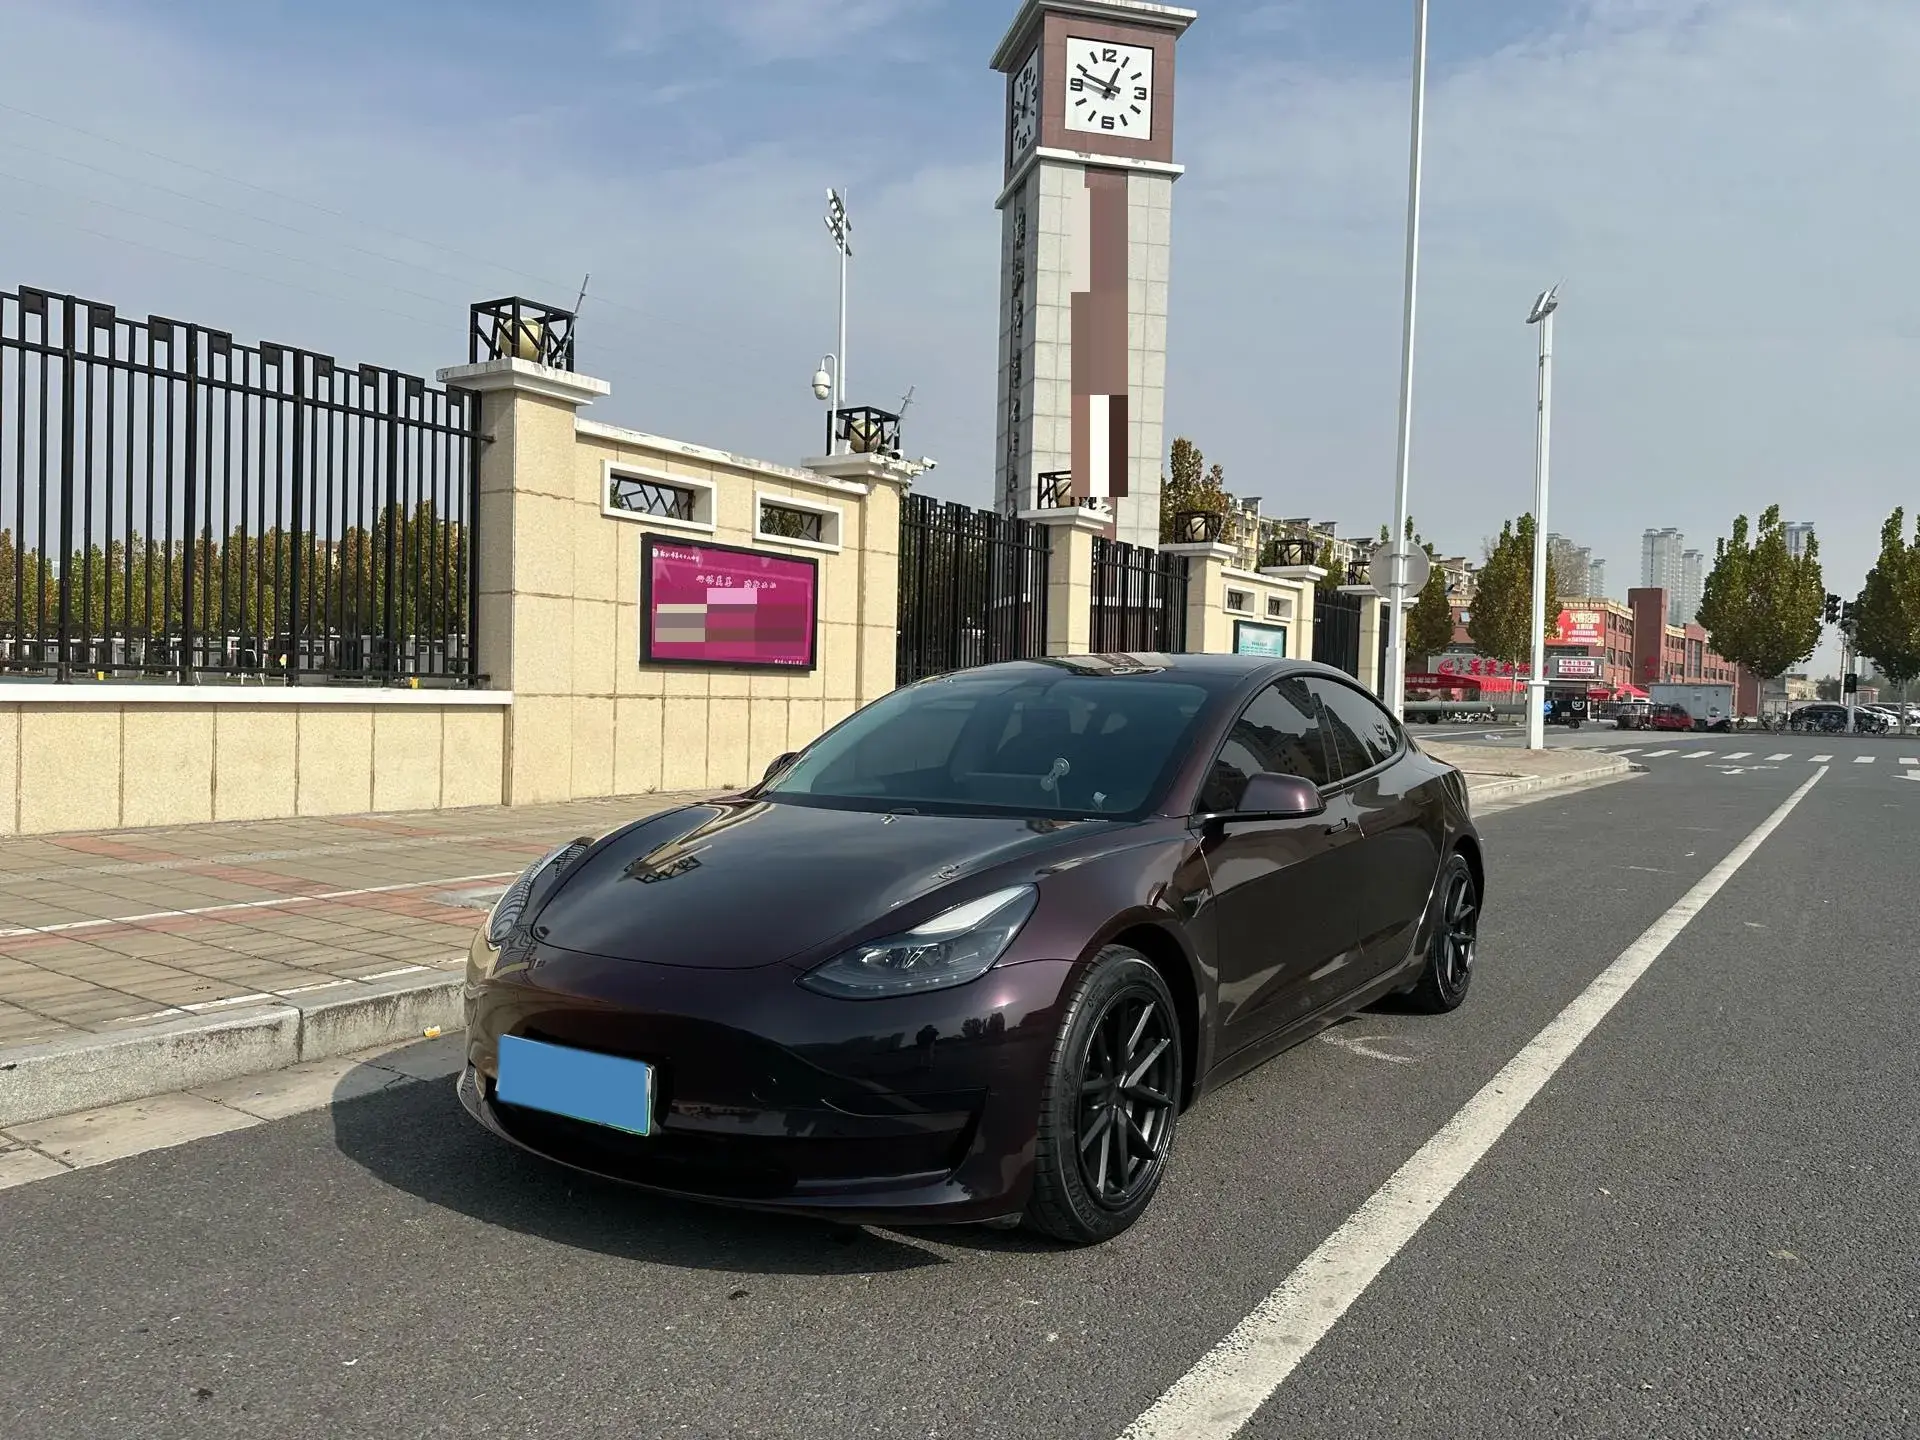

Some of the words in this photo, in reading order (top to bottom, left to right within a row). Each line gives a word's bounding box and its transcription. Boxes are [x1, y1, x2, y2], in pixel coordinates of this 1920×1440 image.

[1102, 48, 1117, 63] 12
[1070, 78, 1084, 92] 9
[1134, 87, 1147, 101] 3
[1101, 116, 1115, 130] 6
